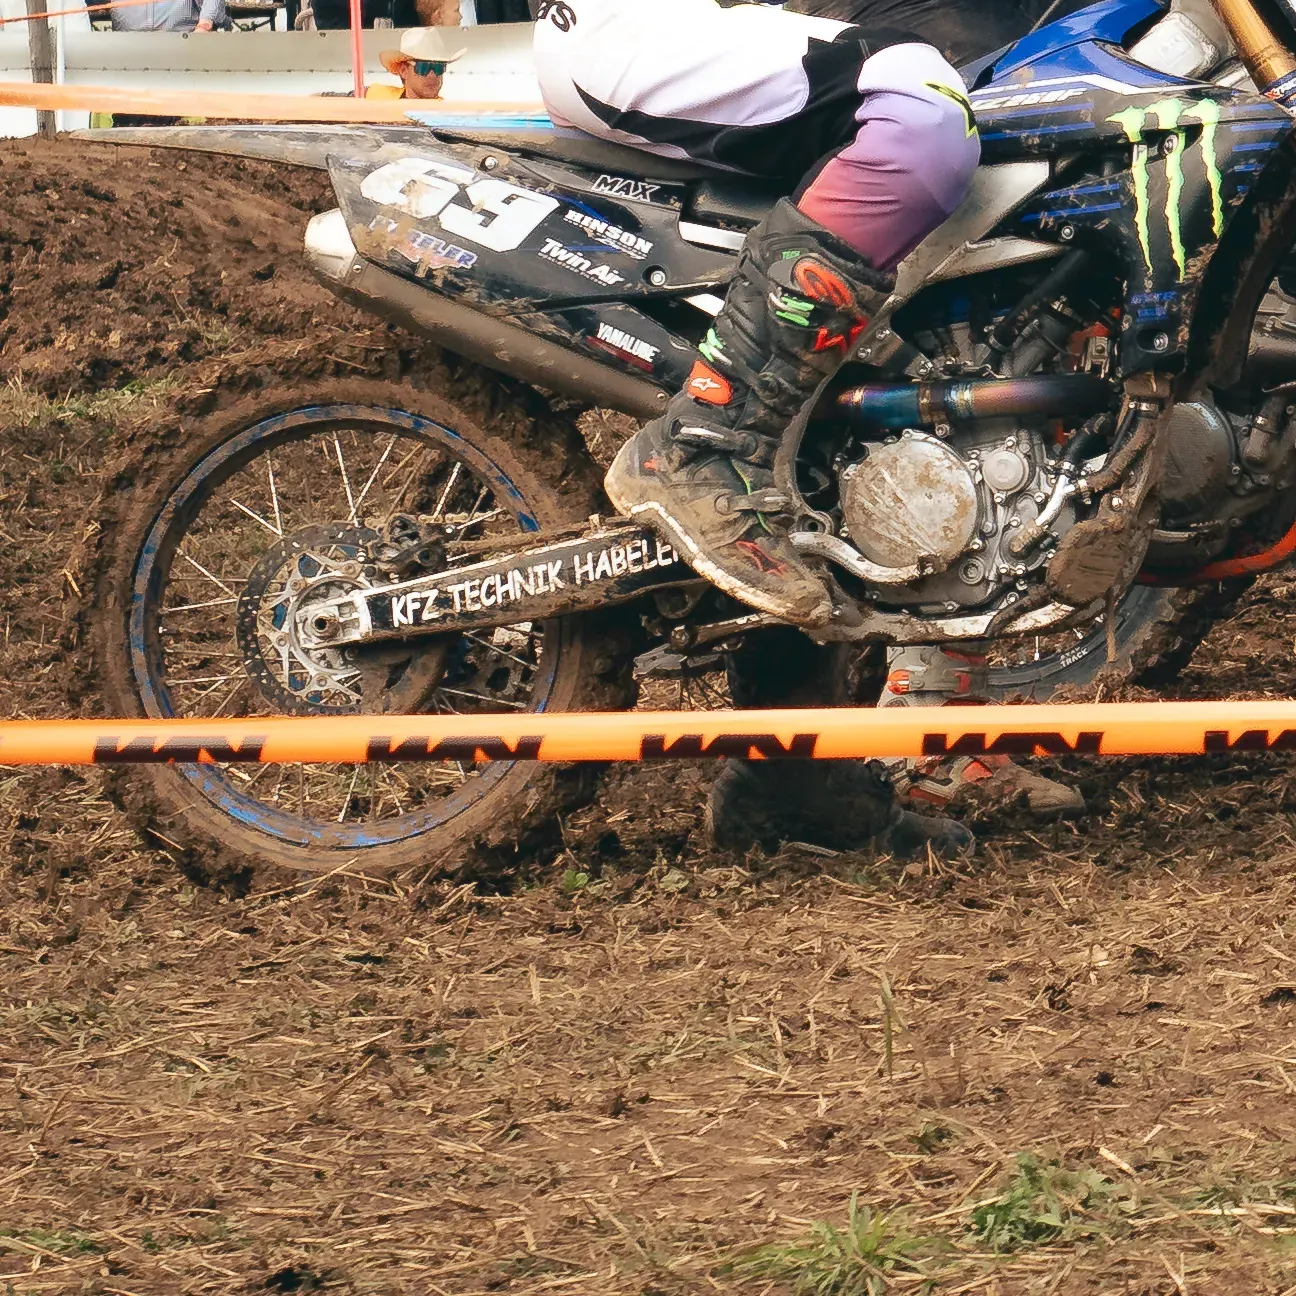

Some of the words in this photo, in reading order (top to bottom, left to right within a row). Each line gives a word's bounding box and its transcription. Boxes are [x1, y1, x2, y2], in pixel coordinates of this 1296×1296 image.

[591, 174, 660, 202] MAX
[563, 208, 654, 255] HINSON
[540, 237, 592, 270] Twin
[587, 262, 625, 286] Air
[391, 588, 441, 627] KFZ
[447, 559, 565, 612] TECHNIK
